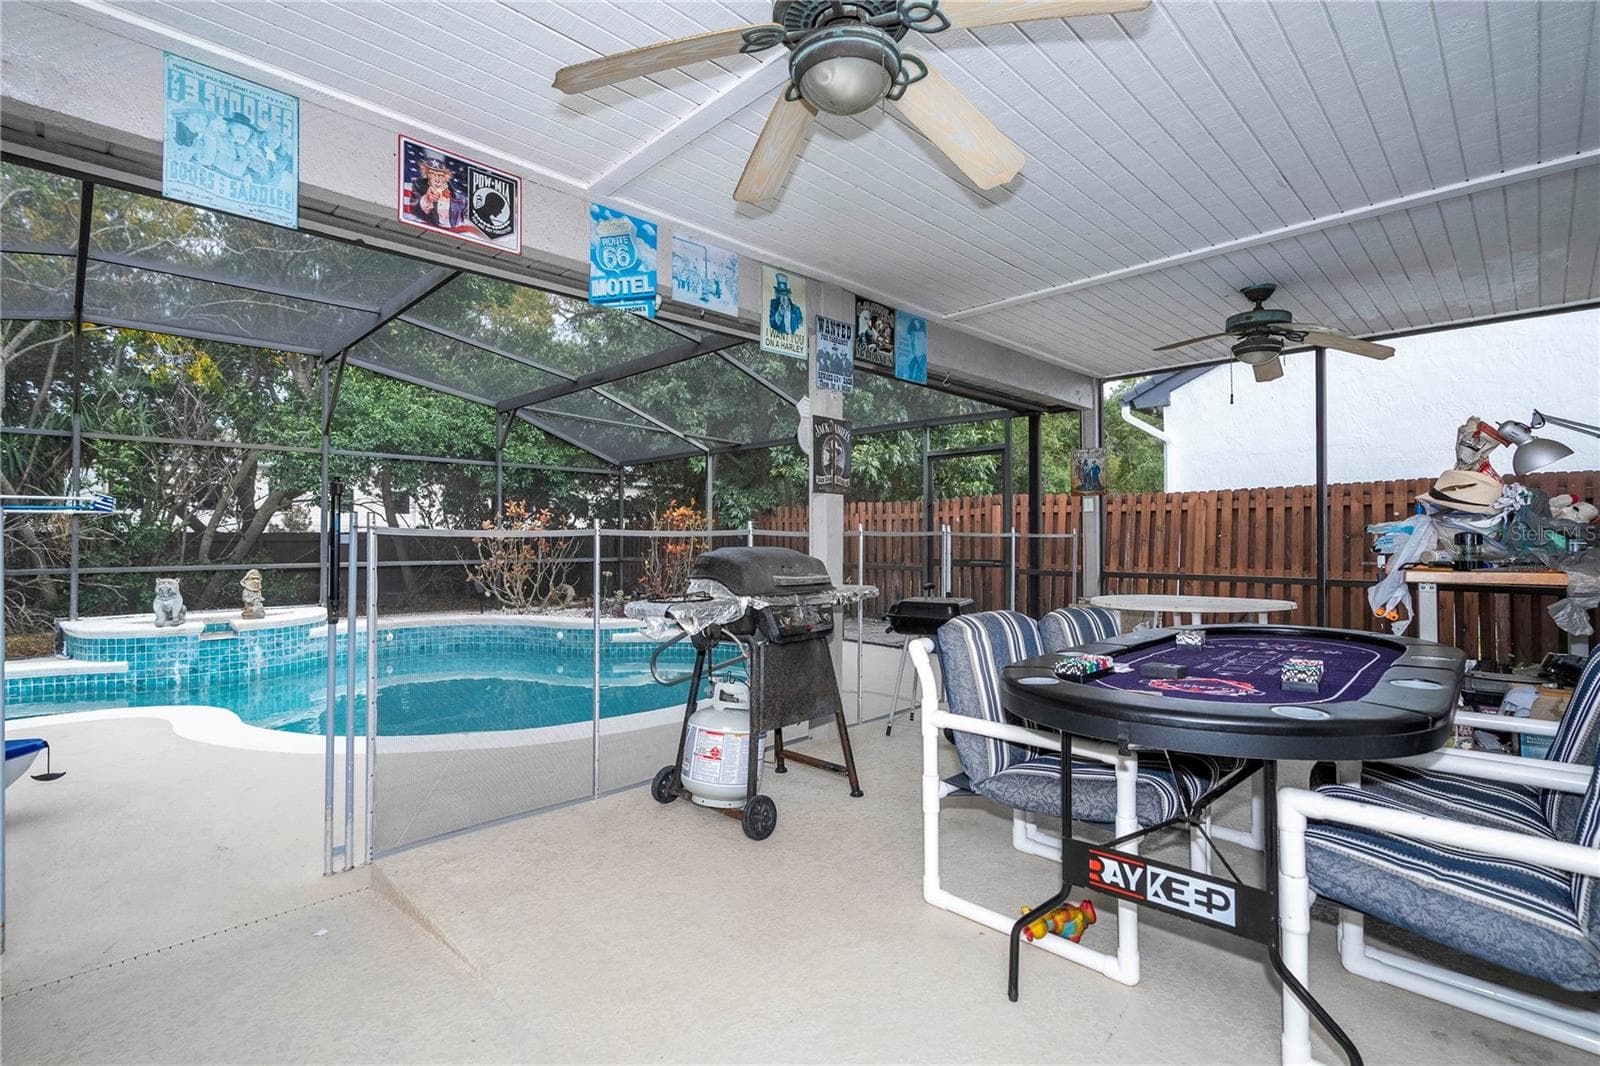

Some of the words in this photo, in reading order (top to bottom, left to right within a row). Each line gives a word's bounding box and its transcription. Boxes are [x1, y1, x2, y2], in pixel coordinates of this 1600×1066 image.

[204, 81, 294, 140] STOOGES
[229, 180, 291, 209] SADDLES
[603, 236, 629, 247] ROUTE
[603, 245, 630, 268] 66
[592, 274, 654, 297] MOTEL
[770, 328, 789, 341] WANT
[789, 335, 804, 345] YOU
[818, 317, 852, 340] WANTED
[781, 341, 804, 353] HARLEY
[815, 423, 829, 438] JACK
